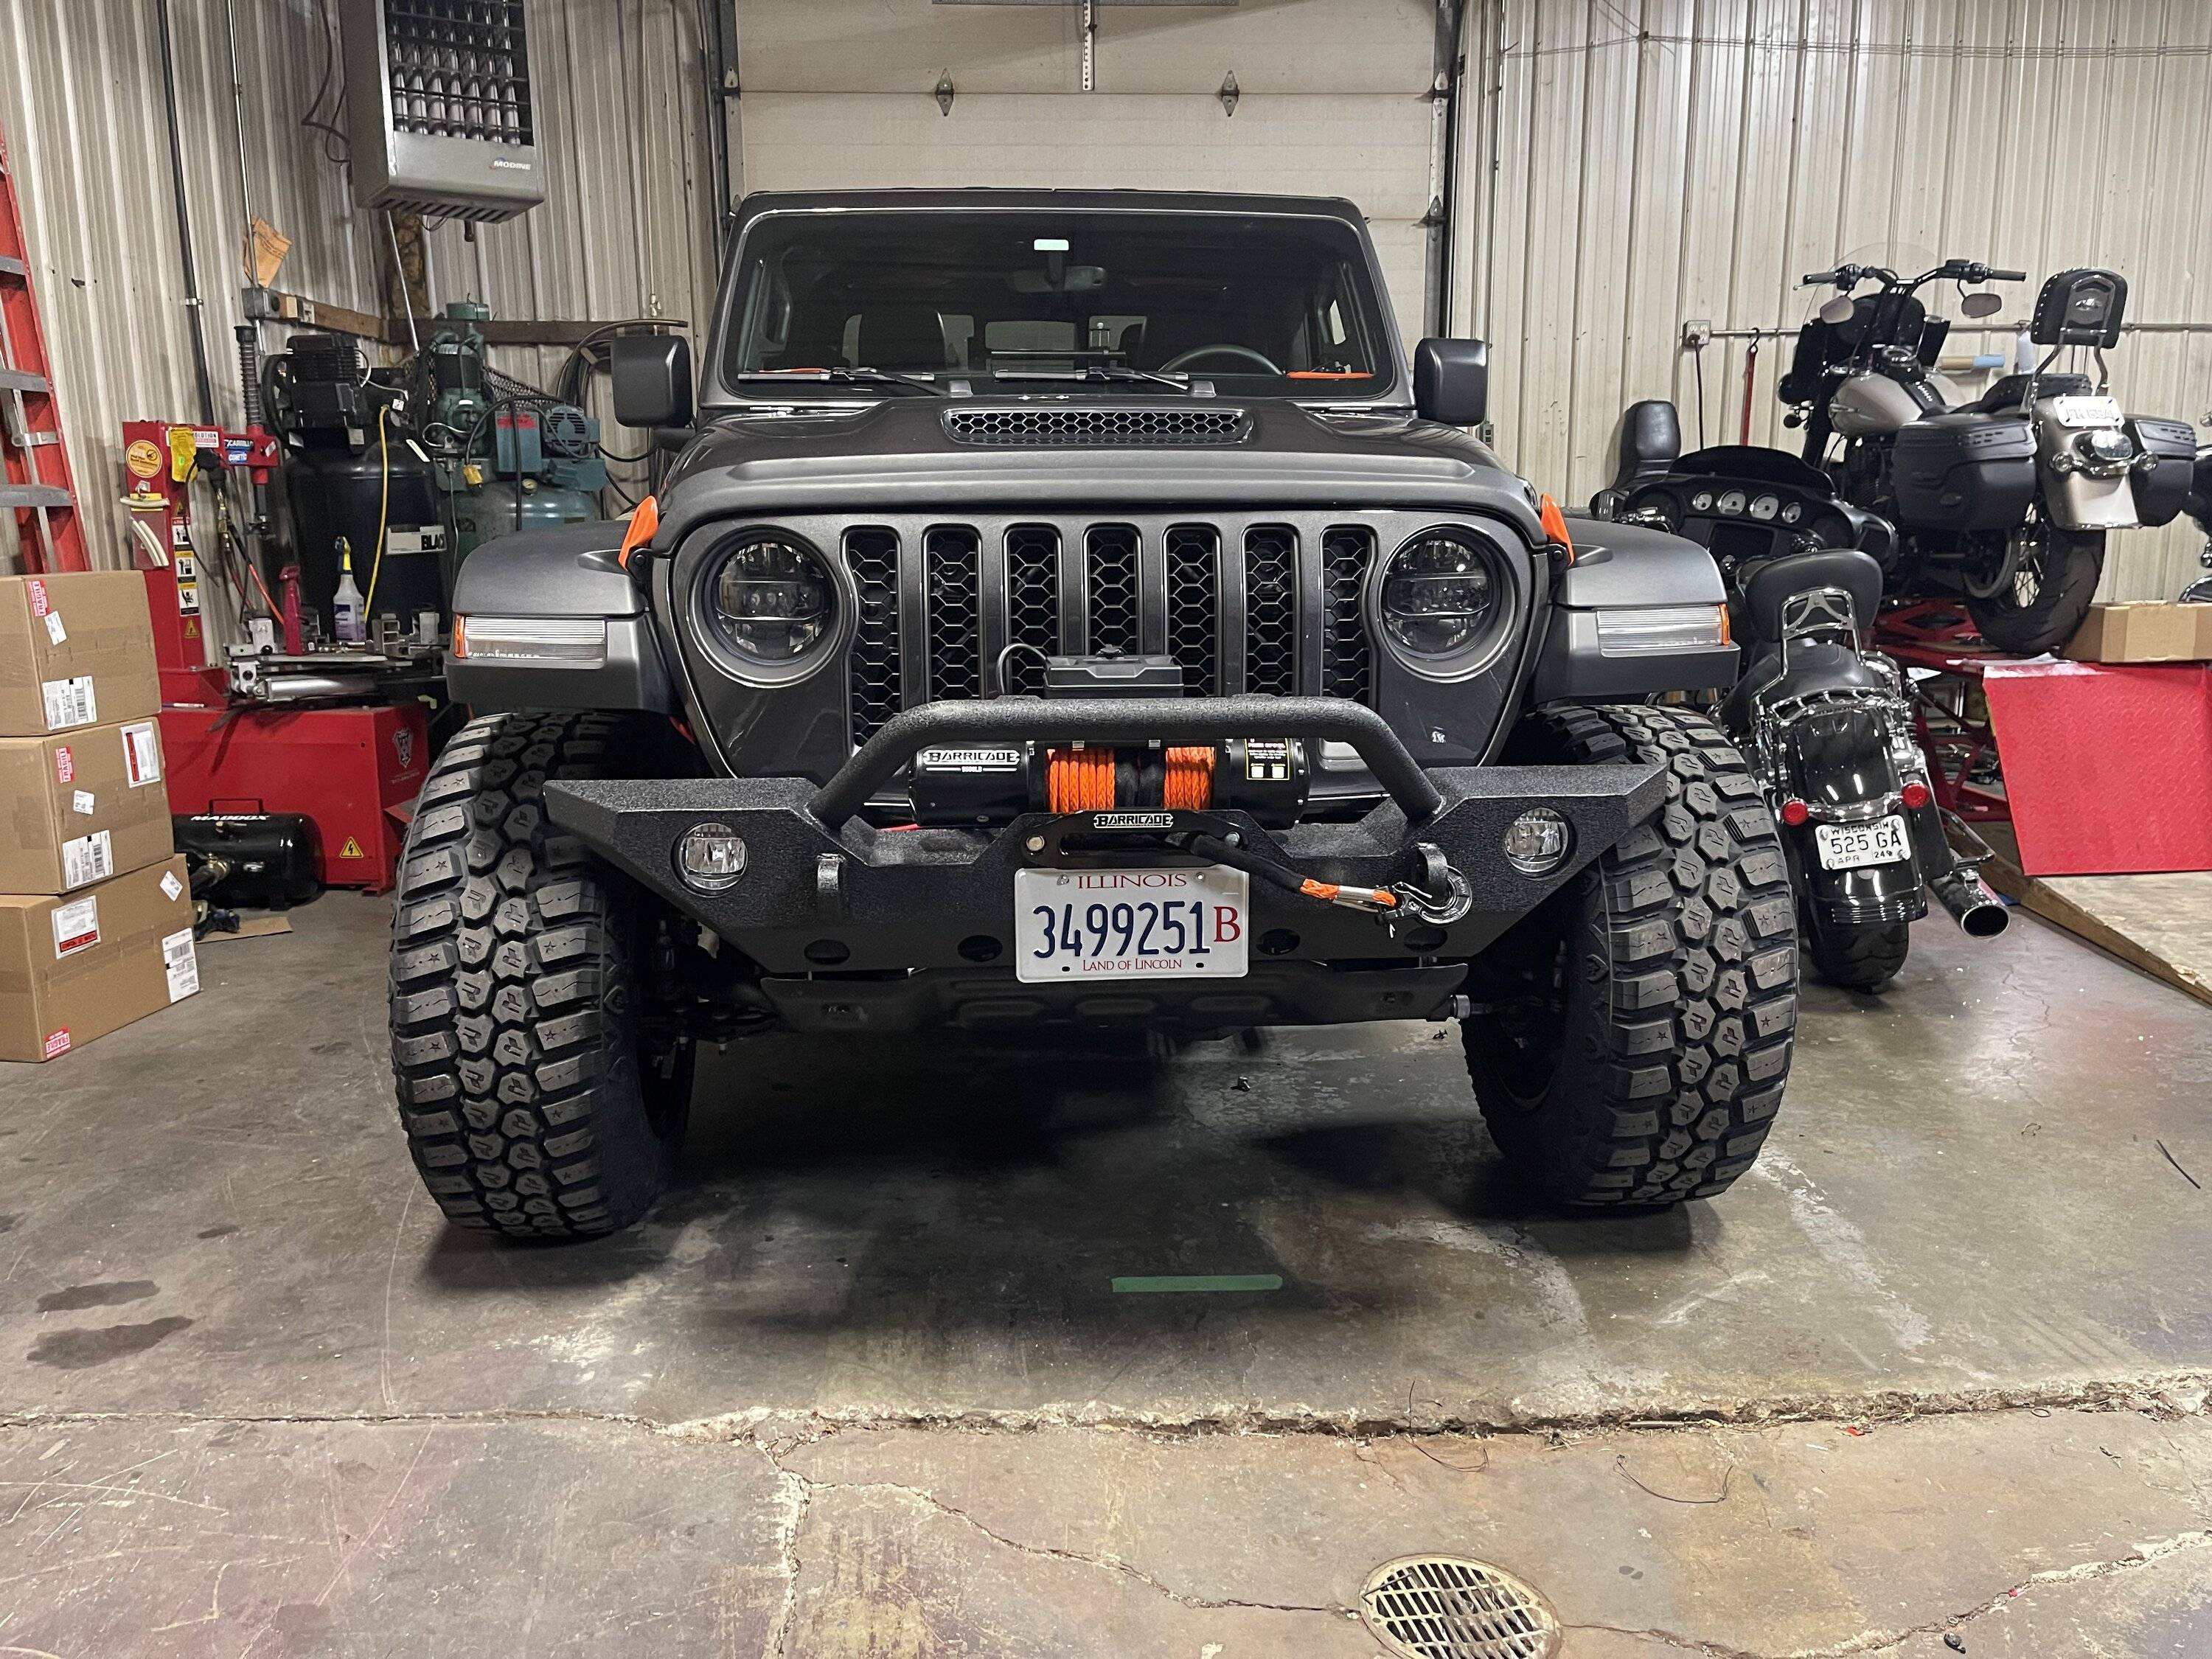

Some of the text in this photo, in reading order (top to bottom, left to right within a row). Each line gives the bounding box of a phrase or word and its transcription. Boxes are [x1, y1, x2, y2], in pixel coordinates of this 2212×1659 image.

[494, 161, 531, 170] MODINE
[34, 582, 45, 616] FRAGILE
[926, 751, 1018, 762] BARRICADE
[60, 750, 71, 782] FRAGILE
[1096, 815, 1172, 826] BARRICADE
[1831, 821, 1889, 835] WISCONSIN
[1831, 831, 1902, 854] 525 GA
[1077, 873, 1188, 889] ILLINOIS
[1032, 900, 1241, 959] 3499251 B
[1082, 958, 1183, 971] LAND OF LINCOLN
